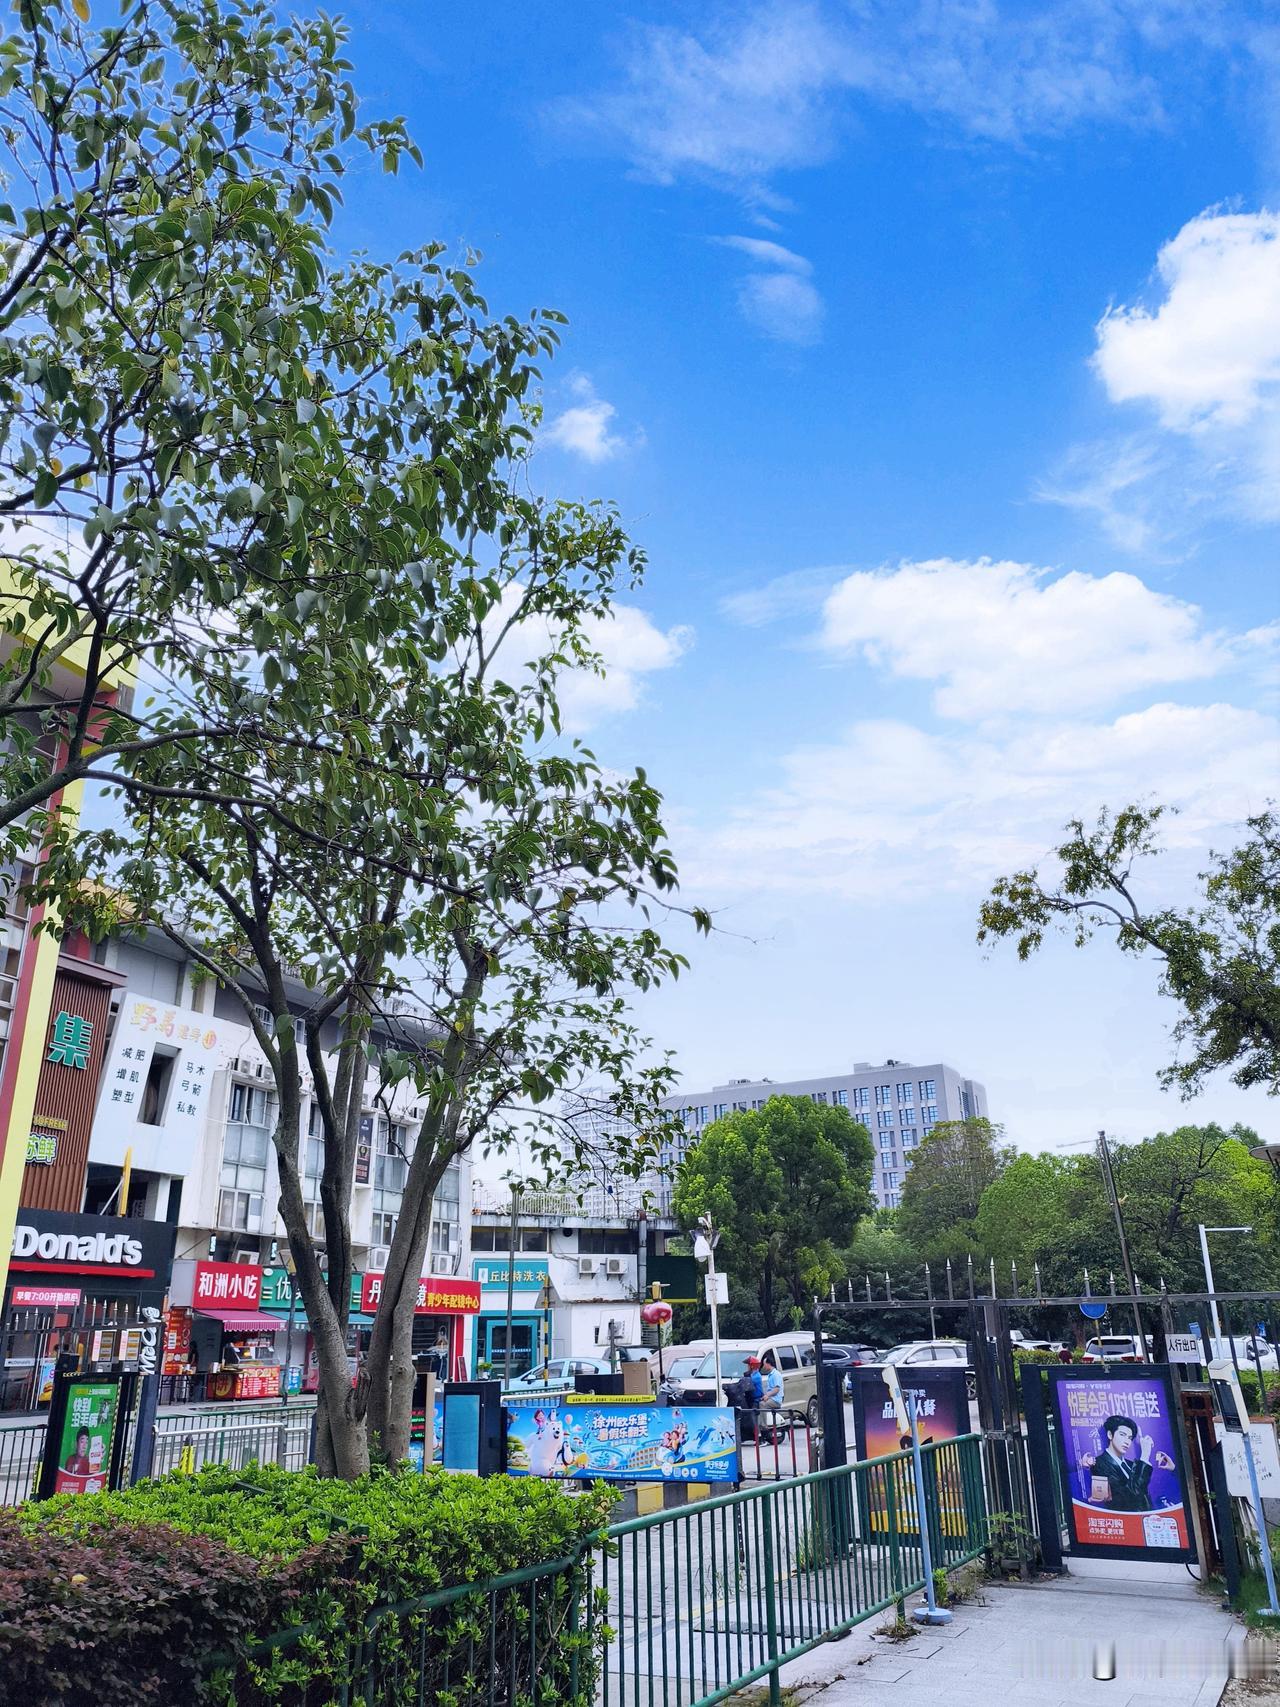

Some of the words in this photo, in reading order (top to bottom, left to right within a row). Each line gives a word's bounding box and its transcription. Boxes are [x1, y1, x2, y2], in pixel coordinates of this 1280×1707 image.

[46, 1010, 94, 1070] 集
[122, 1047, 146, 1061] 减肥
[116, 1068, 140, 1083] 增肌
[112, 1088, 135, 1104] 塑型
[181, 1080, 202, 1096] 弓箭
[177, 1101, 197, 1116] 私教
[13, 1225, 143, 1265] Donald's
[489, 1269, 546, 1282] 丘比特洗衣
[198, 1271, 259, 1300] 和洲小吃
[427, 1292, 480, 1309] 青少年配镜中心
[1168, 1338, 1197, 1352] 人行出口
[1067, 1391, 1161, 1418] 悦享会员1对1急送
[593, 1413, 648, 1429] 徐州欧乐堡
[1088, 1517, 1124, 1529] 淘宝闪购
